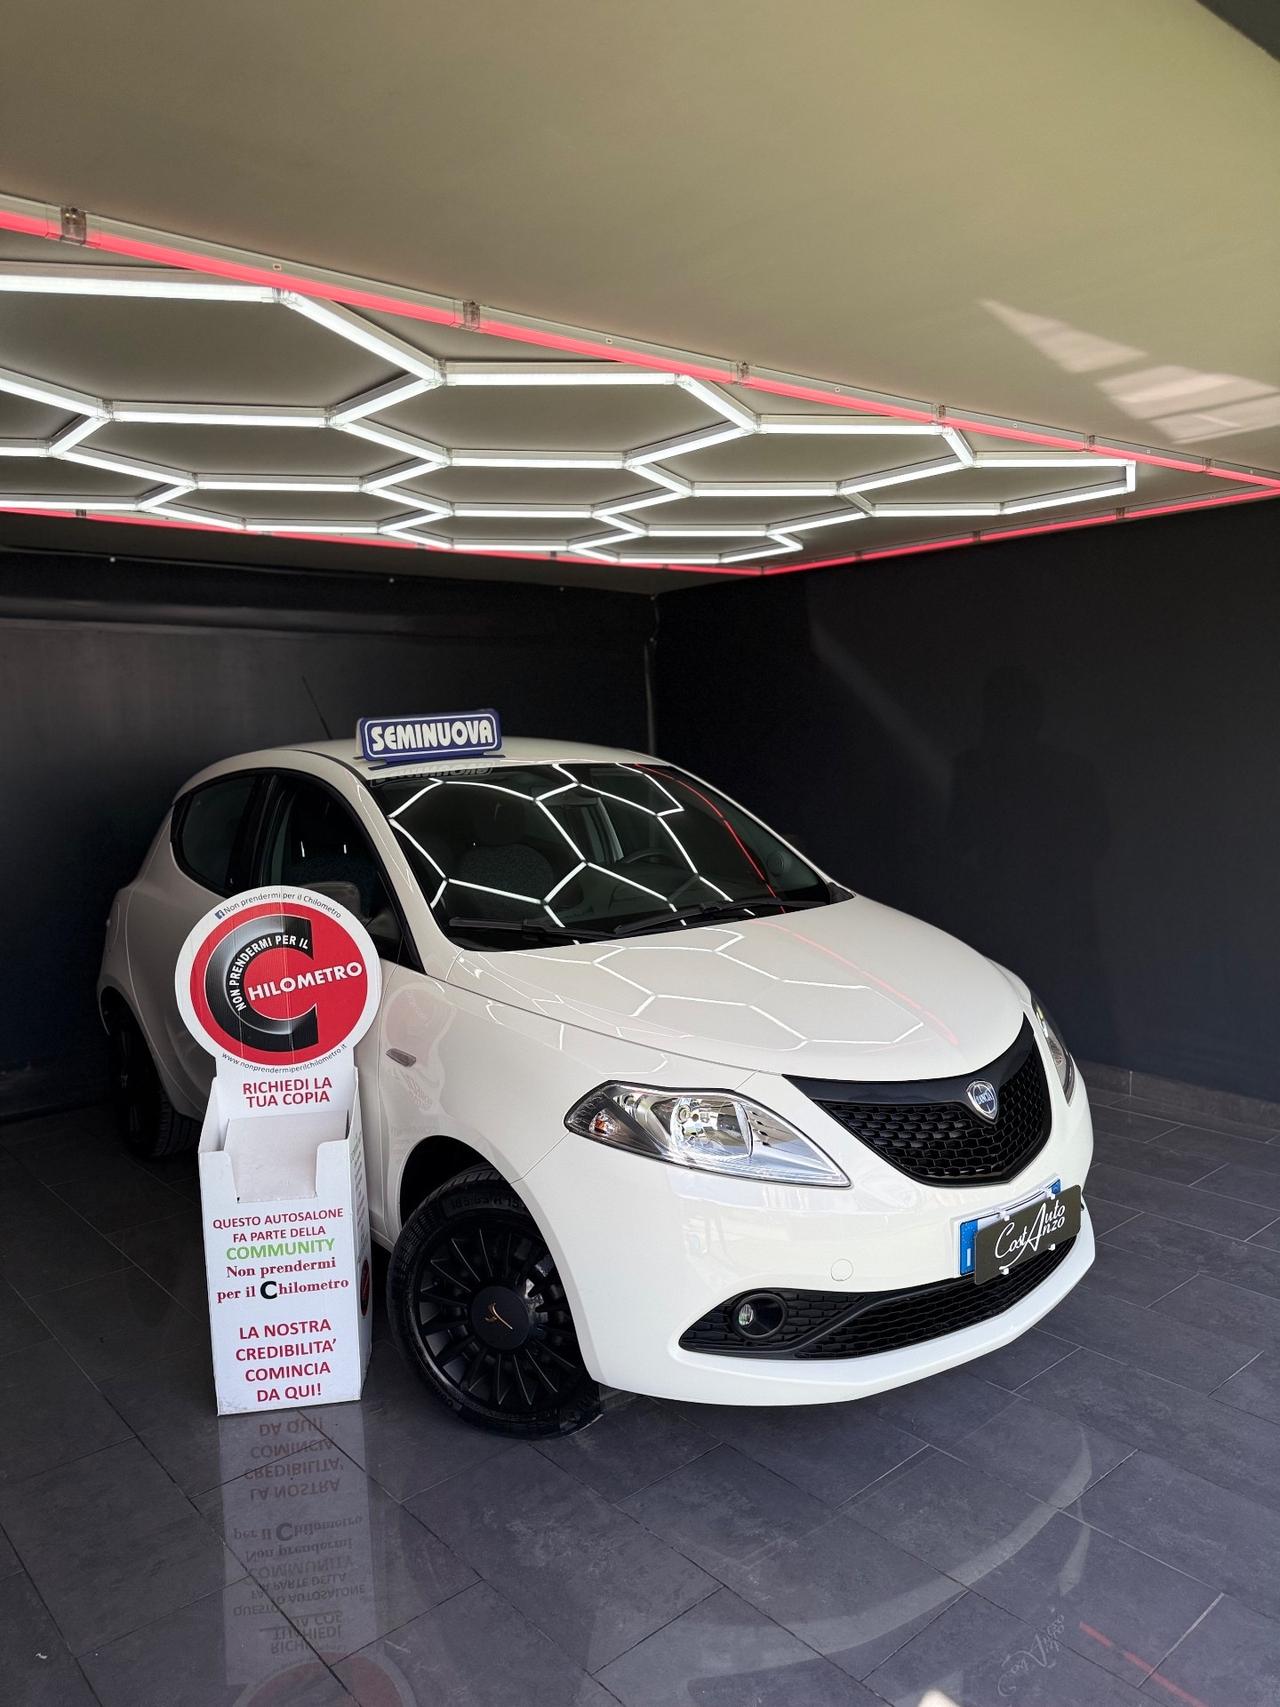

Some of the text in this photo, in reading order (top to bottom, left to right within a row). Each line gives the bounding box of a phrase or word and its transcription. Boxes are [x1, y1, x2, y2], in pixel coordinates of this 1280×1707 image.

[371, 719, 493, 751] SEMINUOVA
[223, 903, 240, 915] Non
[240, 892, 281, 908] prendermi
[282, 892, 296, 901] per
[297, 892, 303, 900] il
[303, 895, 342, 919] Chilometro
[229, 934, 310, 1011] NON PRENDERMI PER IL
[242, 1077, 332, 1095] RICHIEDI LA
[246, 1090, 330, 1108] TUA COPIA
[213, 1208, 344, 1230] QUESTO AUTOSALONE
[233, 1225, 326, 1243] FA PARTE DELLA
[226, 1238, 335, 1260] COMMUNITY
[227, 1257, 336, 1278] Non prendermi
[217, 1279, 349, 1303] per il Chilometro
[239, 1318, 331, 1340] LA NOSTRA
[245, 1361, 331, 1382] COMINCIA
[257, 1383, 322, 1402] DA QUI!
